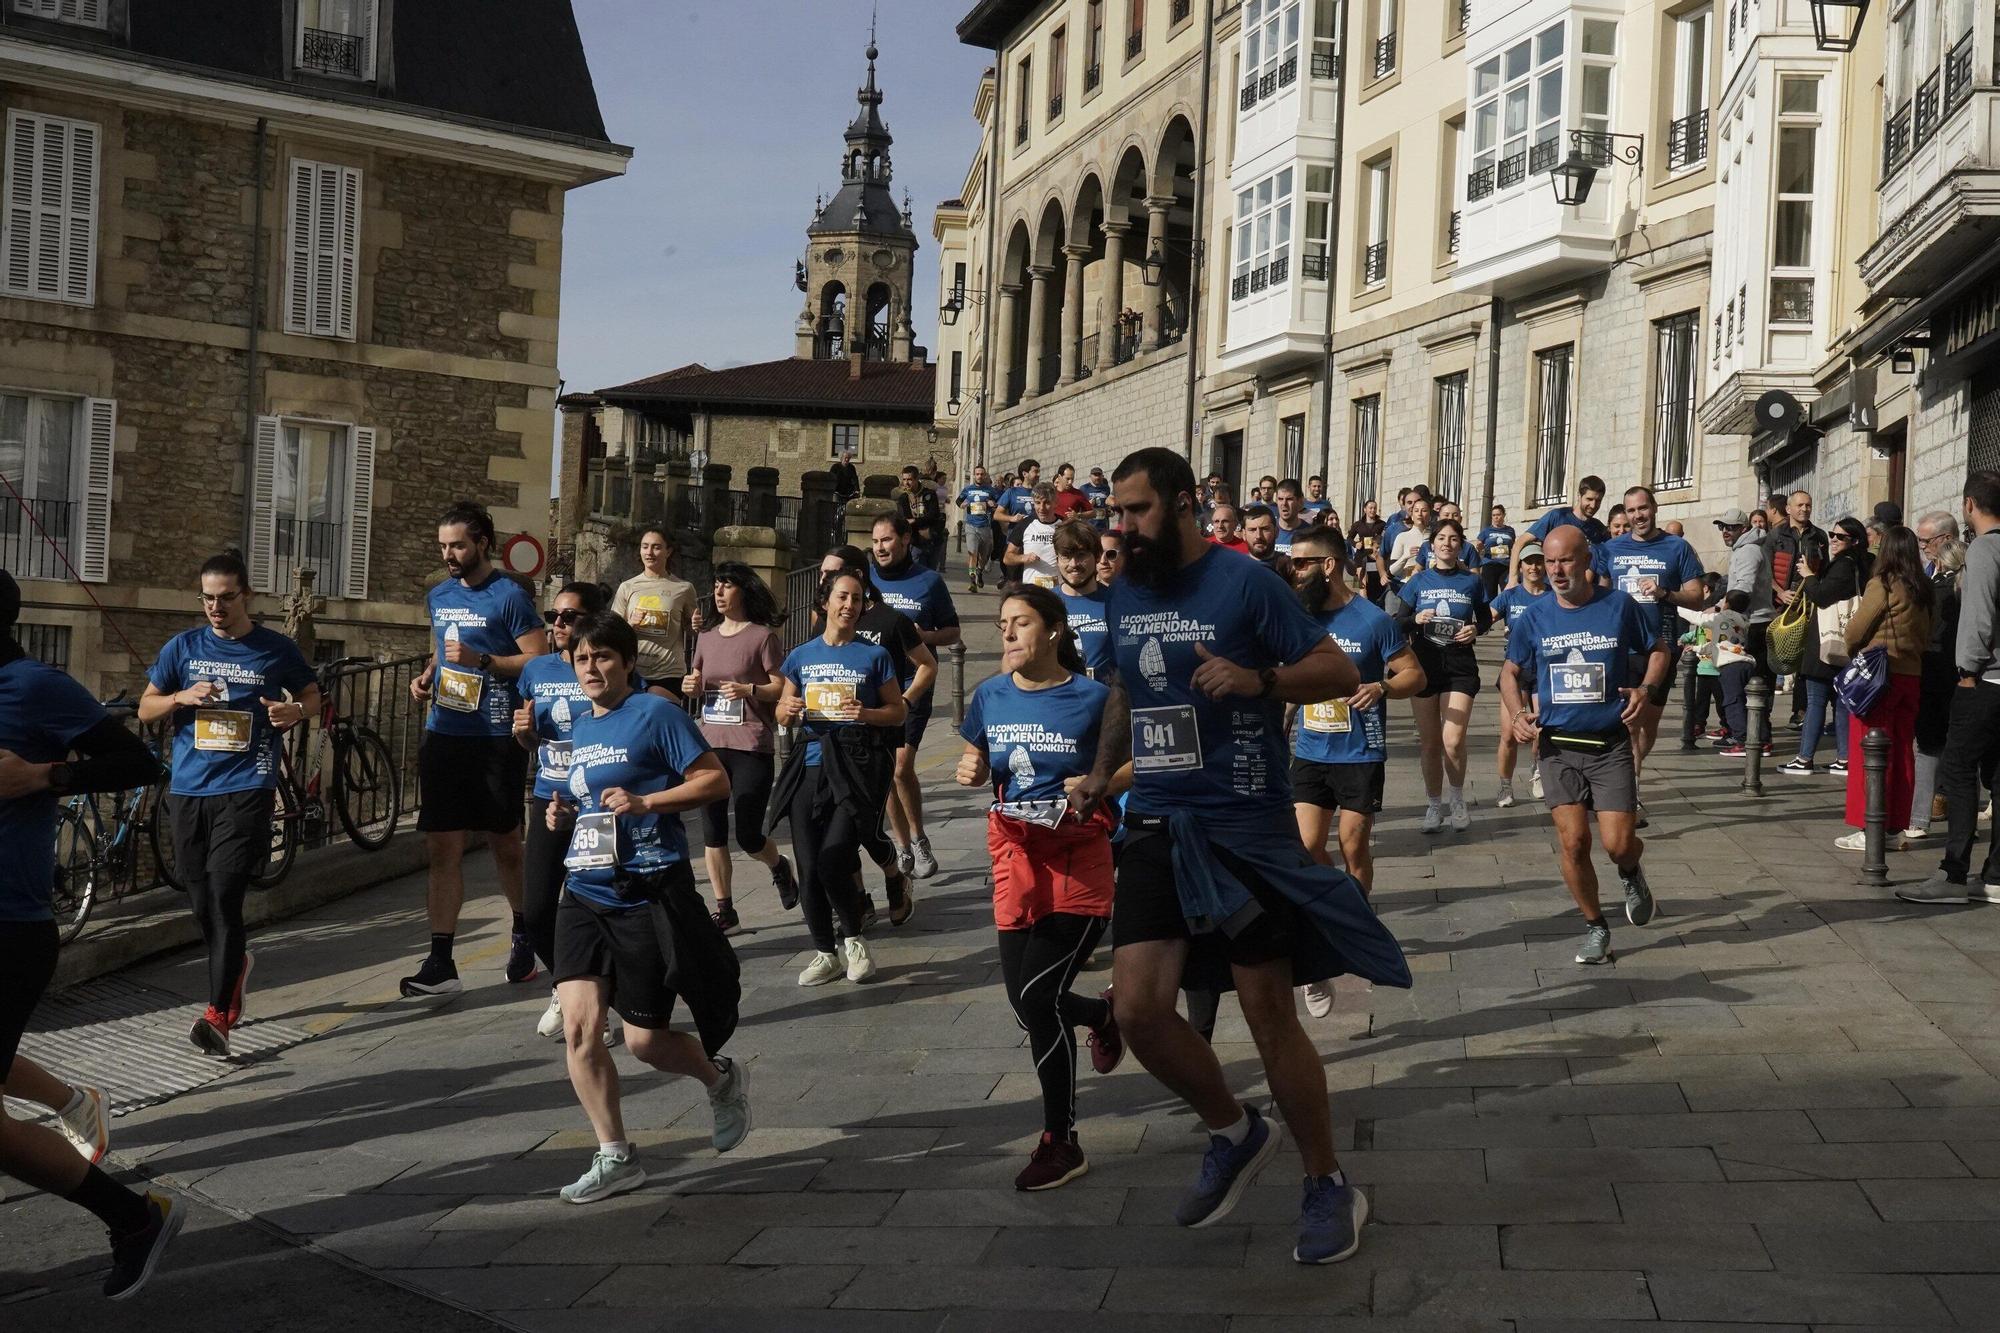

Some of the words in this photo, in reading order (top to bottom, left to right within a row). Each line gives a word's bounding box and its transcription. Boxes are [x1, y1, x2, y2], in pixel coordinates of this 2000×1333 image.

[1879, 448, 1884, 458] 2
[440, 613, 478, 621] ALMENDRA
[1121, 615, 1129, 624] LA
[1129, 611, 1179, 624] CONQUISTA
[1128, 619, 1200, 635] ALMENDRA
[1435, 623, 1454, 636] 823
[1162, 631, 1216, 643] KONKISTA
[1550, 631, 1592, 643] CONQUISTA
[1552, 635, 1608, 649] ALMENDRA
[1582, 642, 1618, 651] KONKISTA
[198, 660, 241, 669] CONQUISTA
[198, 666, 255, 678] ALMENDRA
[810, 669, 857, 677] ALMENDRA
[228, 677, 264, 685] KONKISTA
[1563, 673, 1592, 688] 964
[446, 679, 467, 697] 456
[543, 687, 584, 696] ALMEND
[817, 692, 840, 706] 415
[1312, 703, 1335, 718] 285
[209, 720, 237, 736] 455
[995, 724, 1044, 733] CONQUISTA
[996, 732, 1064, 744] ALMENDRA
[1143, 723, 1175, 748] 941
[1029, 743, 1077, 753] KONKISTA
[586, 754, 628, 768] KONKISTA
